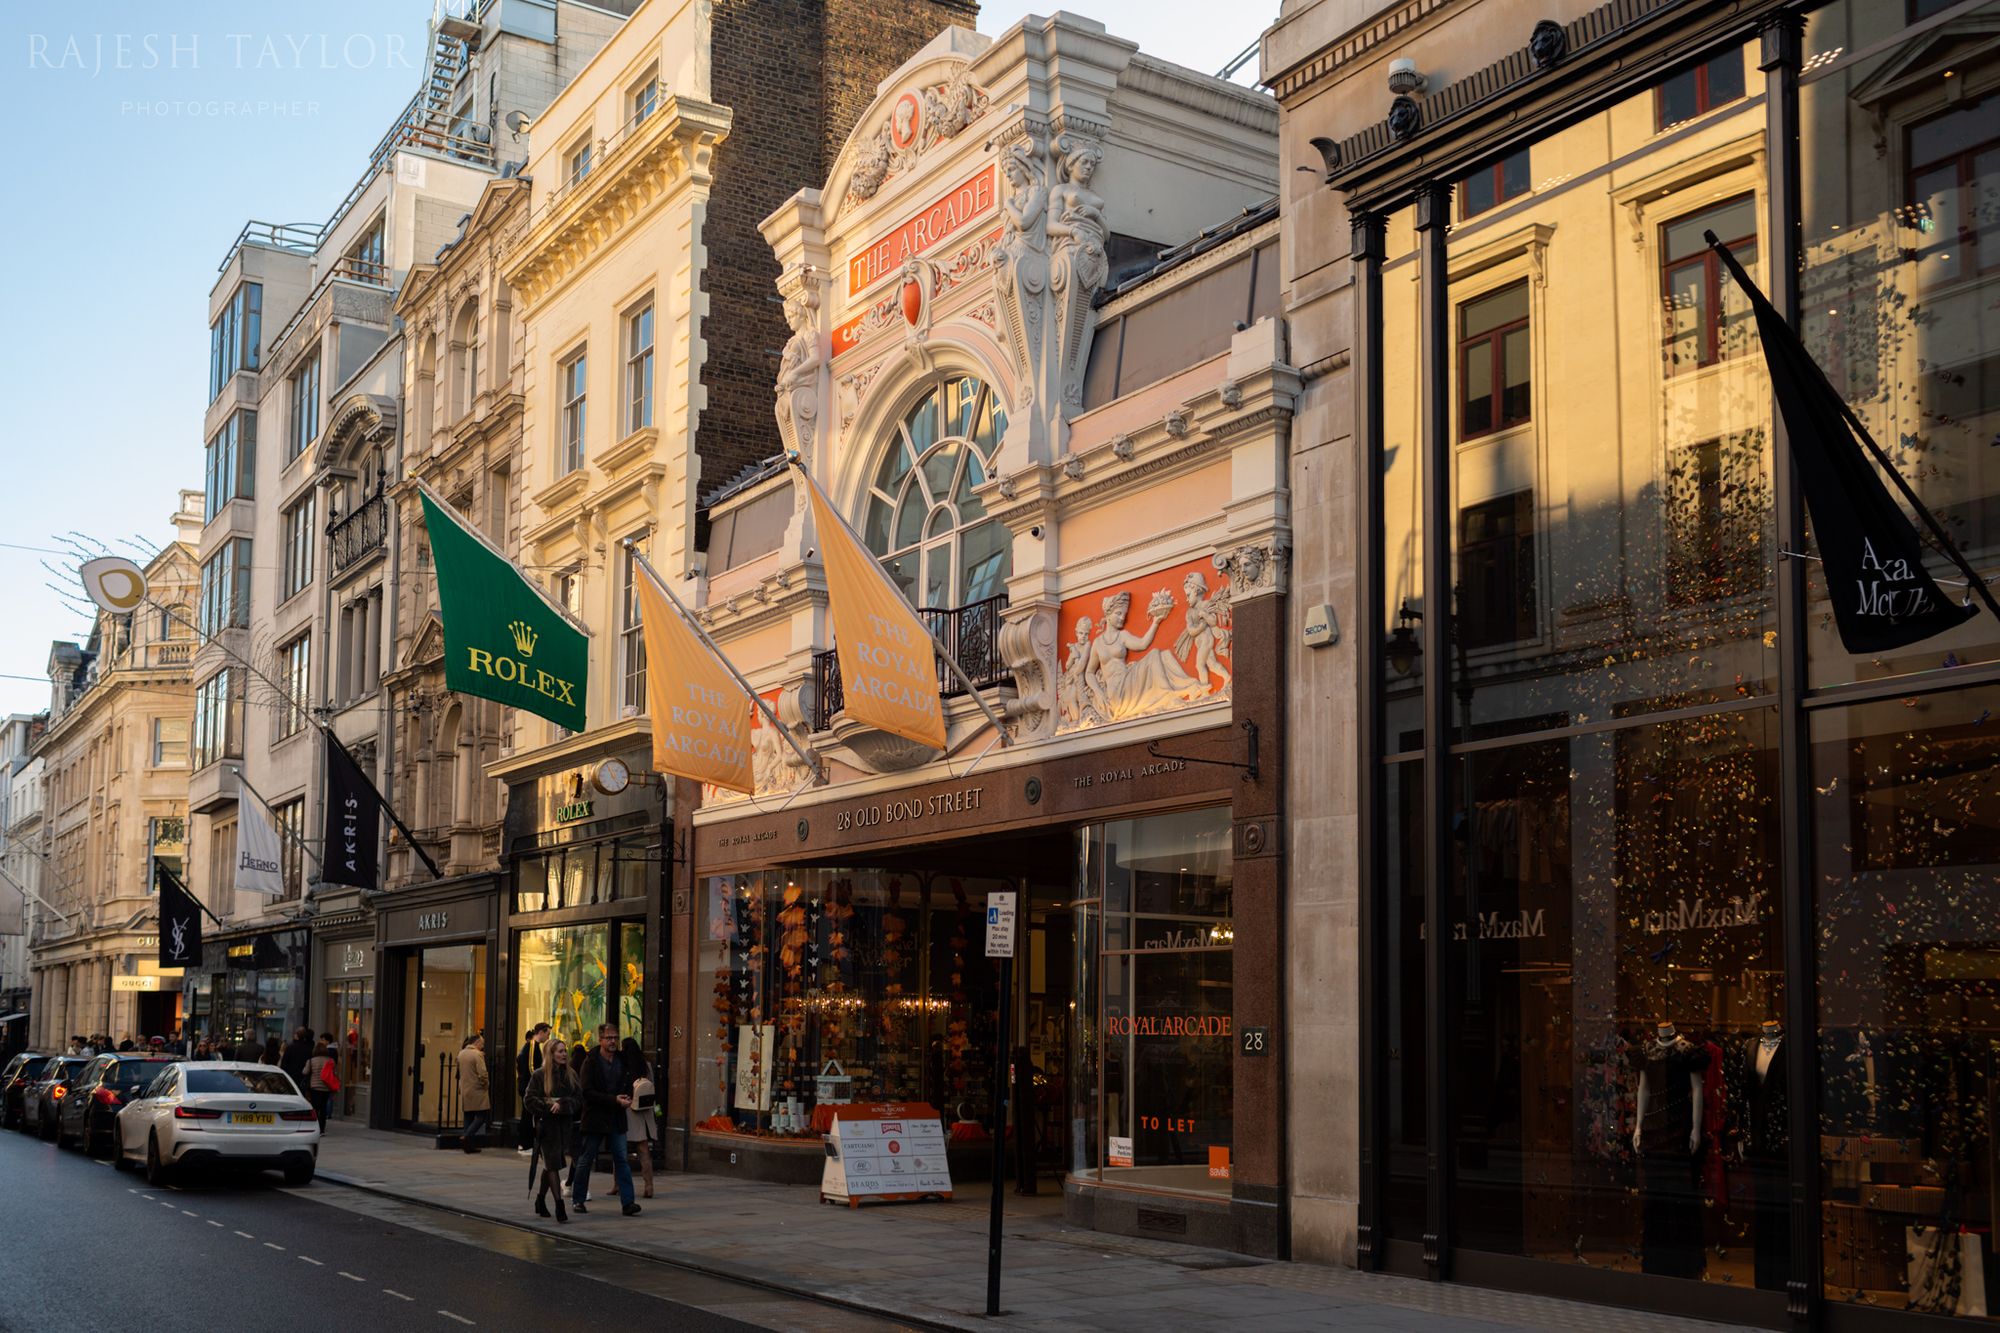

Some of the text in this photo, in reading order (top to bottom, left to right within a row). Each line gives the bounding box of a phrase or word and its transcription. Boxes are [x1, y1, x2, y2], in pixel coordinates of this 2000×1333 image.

[853, 174, 990, 290] THE ARCADE
[868, 613, 912, 649] THE
[1305, 624, 1328, 635] SECOM
[857, 642, 928, 683] ROYAL
[467, 647, 577, 707] ROLEX
[686, 683, 728, 709] THE
[671, 705, 739, 740] ROYAL
[1073, 759, 1186, 789] THE ROYAL ARCADE
[557, 800, 590, 822] ROLEX
[837, 787, 984, 831] 28 OLD BOND STREET
[718, 830, 778, 848] THE ROYAL ARCADE
[418, 912, 448, 930] AKRIS
[674, 1026, 682, 1040] 28
[1109, 1016, 1232, 1036] ROYAL ARCADE
[1245, 1032, 1263, 1050] 28
[255, 1112, 272, 1123] YTU
[1141, 1116, 1195, 1133] TO LET
